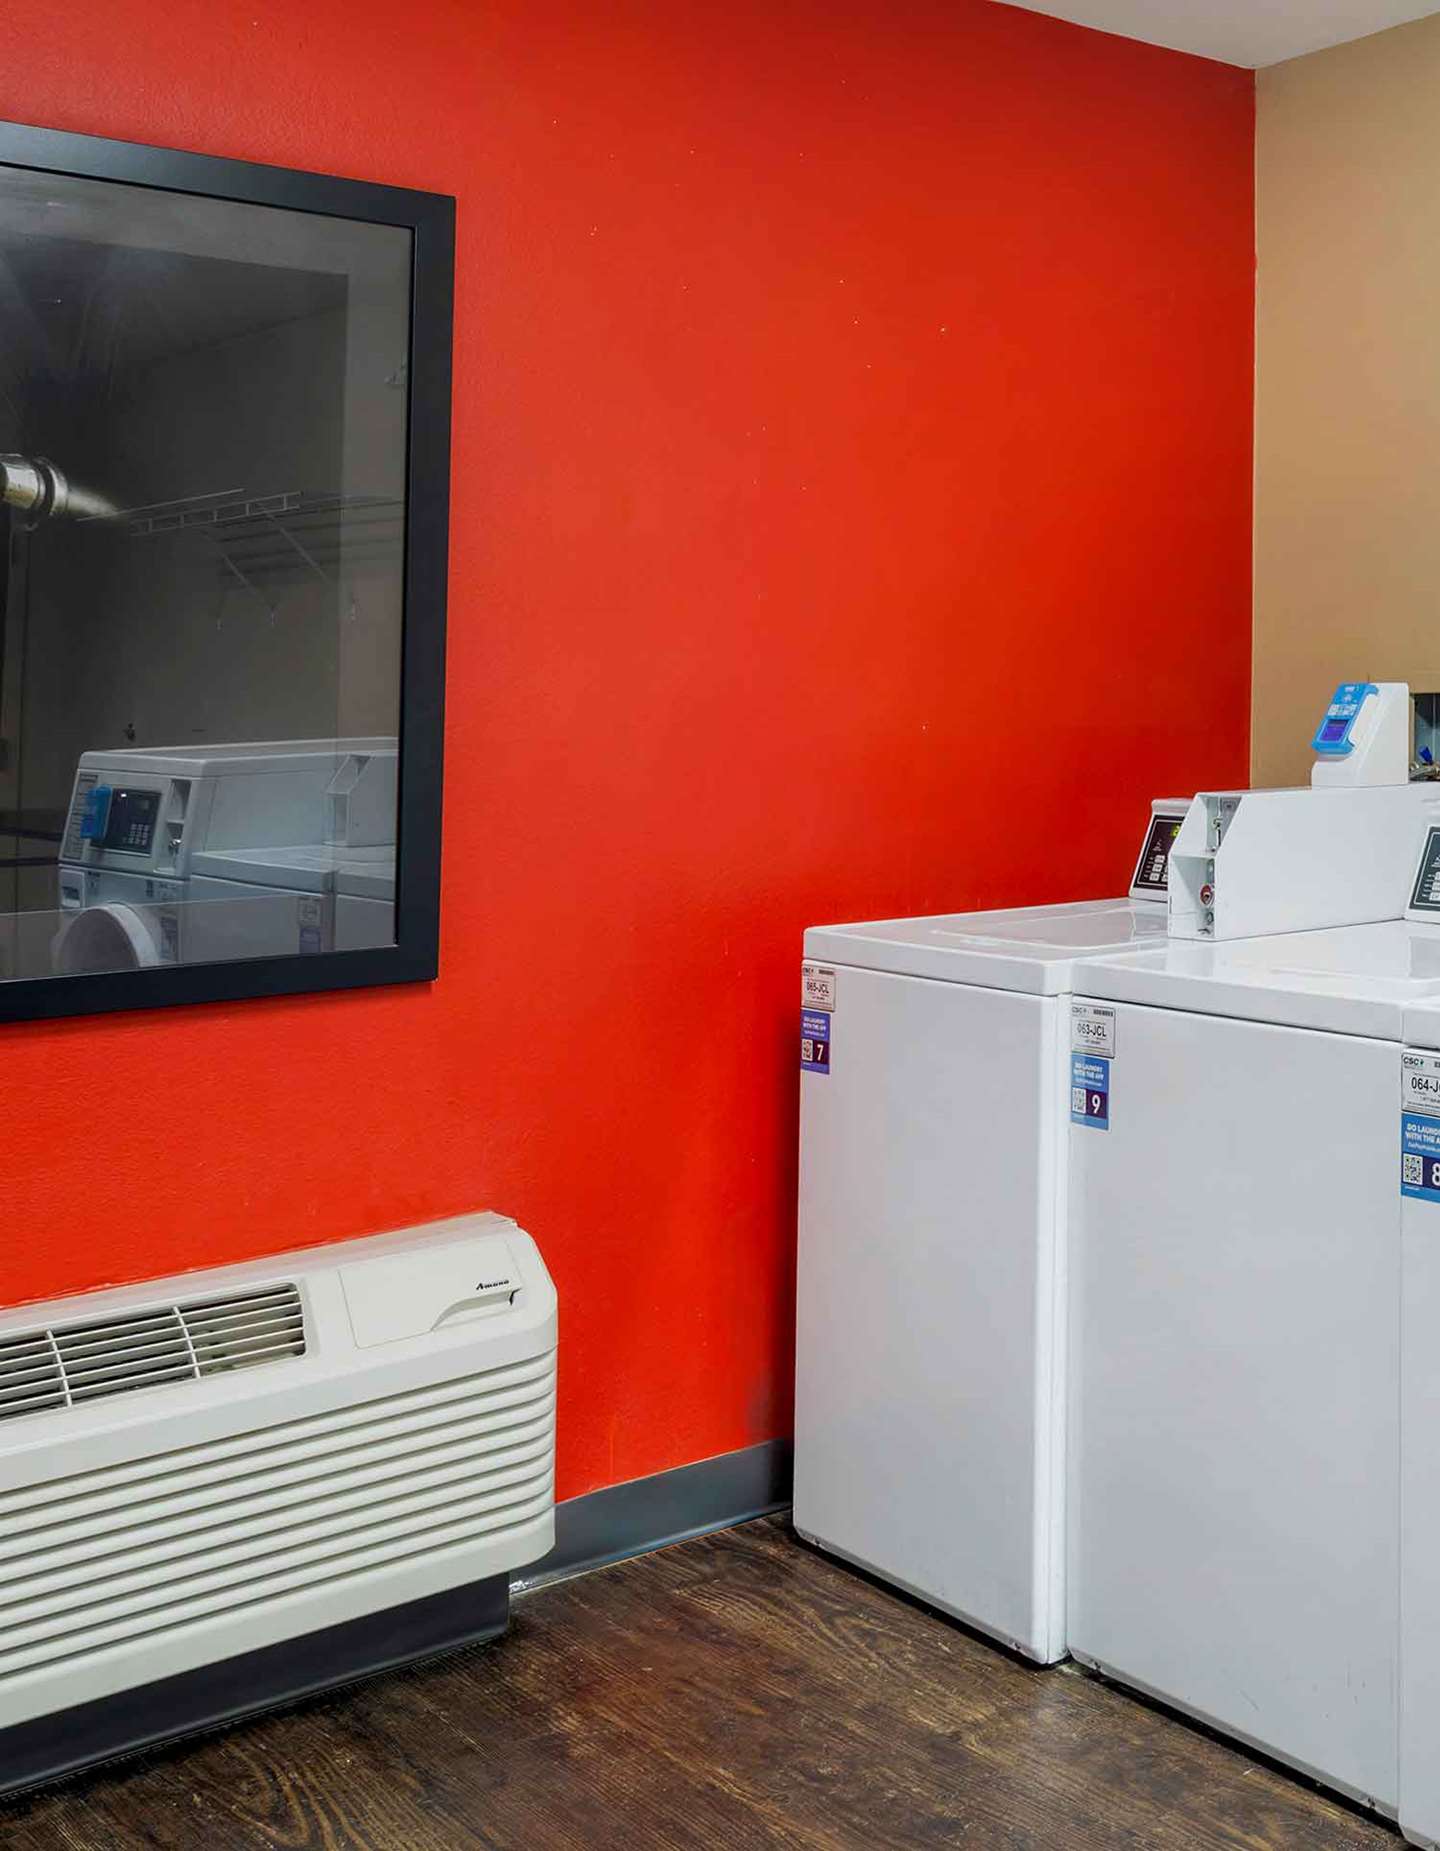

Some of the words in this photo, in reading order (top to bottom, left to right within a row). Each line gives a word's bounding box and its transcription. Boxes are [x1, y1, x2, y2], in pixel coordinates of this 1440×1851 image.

[816, 1043, 824, 1061] 7
[1404, 1057, 1419, 1066] CSC
[1091, 1094, 1101, 1114] 9
